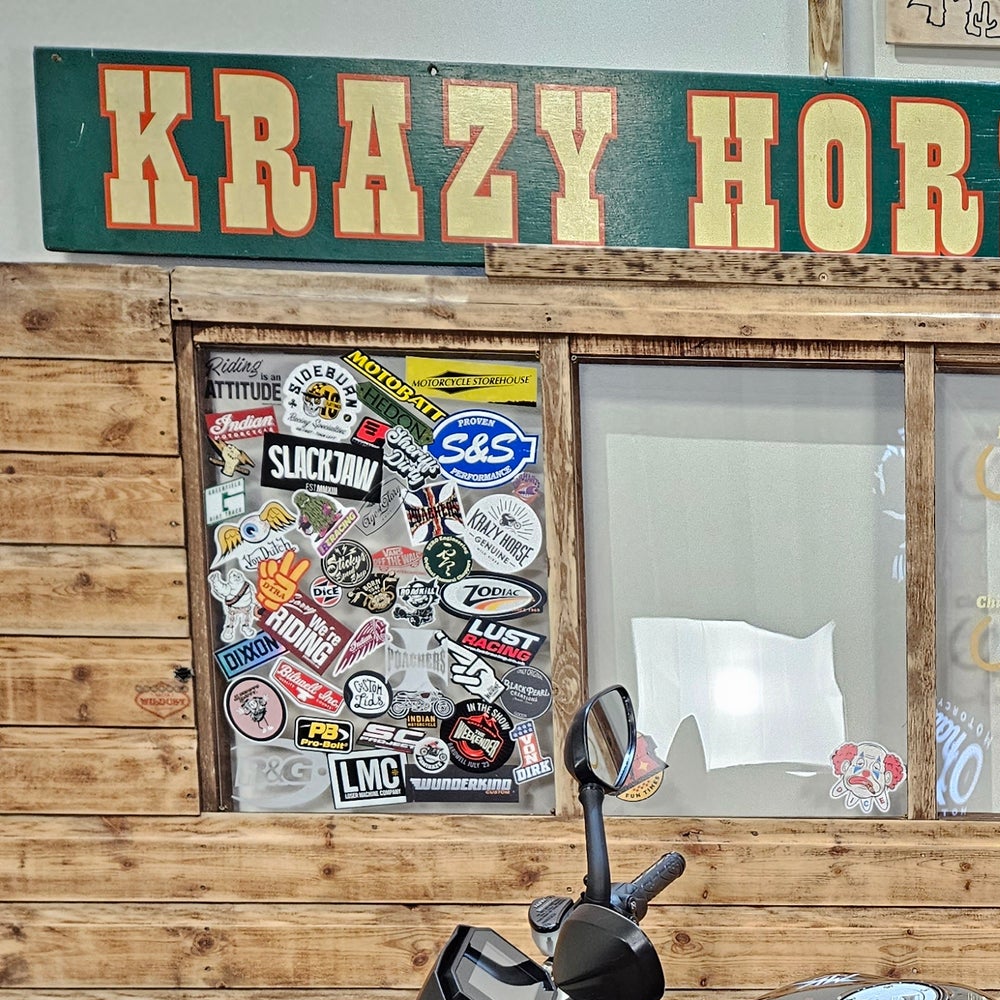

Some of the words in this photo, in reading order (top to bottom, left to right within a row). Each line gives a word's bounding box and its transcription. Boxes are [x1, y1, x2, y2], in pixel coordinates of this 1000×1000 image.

[98, 63, 618, 246] KRAZY
[206, 356, 263, 377] Riding
[260, 373, 269, 381] is
[205, 380, 282, 401] ATTITUDE
[349, 350, 447, 421] MOTOBATT
[412, 376, 471, 388] MOTORCYCLE
[472, 375, 530, 386] STOREHOUSE
[210, 414, 275, 433] Indian
[363, 387, 427, 441] HEDON
[458, 418, 496, 428] PROVEN
[439, 433, 517, 464] S&S
[268, 444, 379, 492] SLACKJAW
[450, 465, 512, 482] PERFORMANCE
[260, 537, 297, 560] Dutch
[467, 508, 504, 541] KRAZY
[499, 534, 534, 567] HORSE
[474, 536, 510, 564] GENUINE
[262, 581, 286, 600] DTRA
[463, 584, 521, 607] ZODIAC
[265, 606, 334, 667] RIDING
[467, 618, 541, 649] LUST
[223, 635, 280, 671] DIXXON
[461, 633, 532, 662] RACING
[408, 715, 436, 723] INDIAN
[466, 703, 476, 712] IN
[477, 702, 492, 714] THE
[491, 709, 511, 730] SHOW
[308, 721, 339, 740] PB
[365, 723, 426, 744] SC
[453, 720, 500, 758] WEEKENDER
[340, 757, 400, 793] LMC
[516, 760, 552, 783] DIRK
[410, 778, 512, 791] WUNDERKIND
